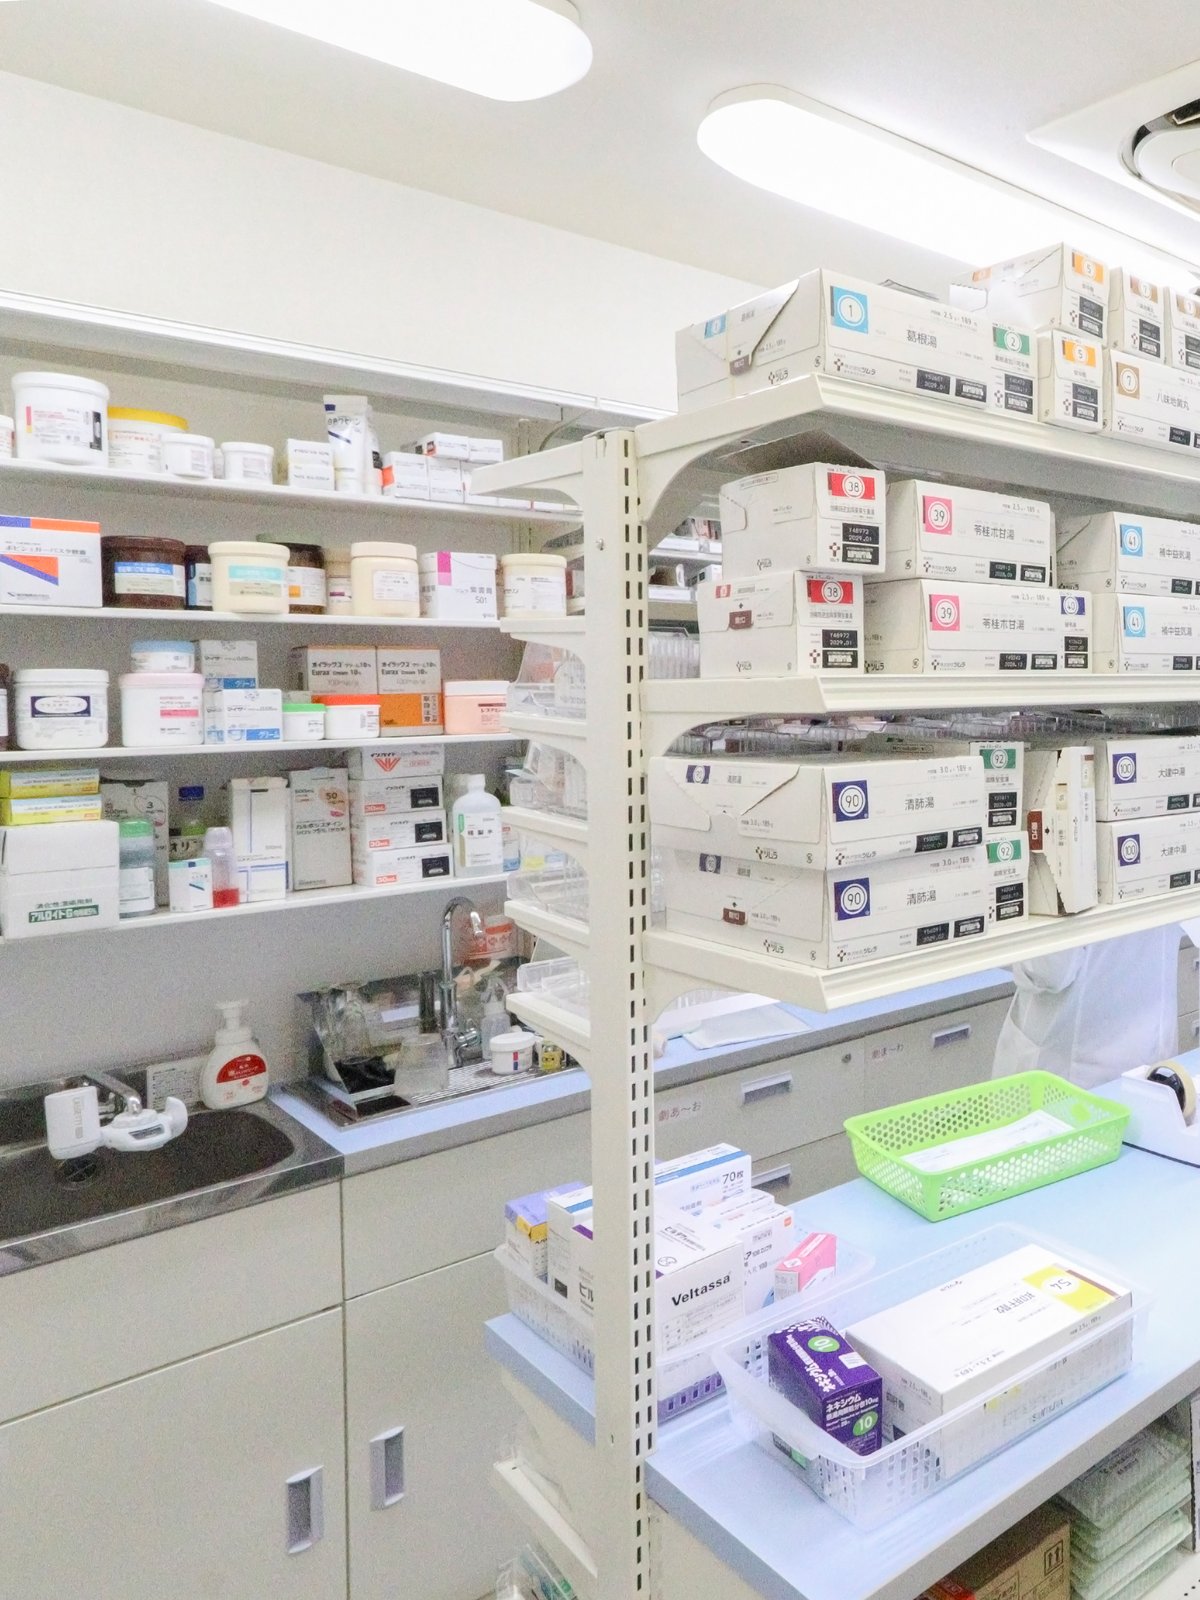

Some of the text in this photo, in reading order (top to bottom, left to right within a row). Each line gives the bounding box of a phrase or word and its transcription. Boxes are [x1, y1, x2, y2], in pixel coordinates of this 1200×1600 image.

[906, 329, 938, 348] 葛根湯
[847, 481, 860, 493] 38
[933, 508, 946, 522] 39
[827, 586, 839, 598] 38
[940, 606, 953, 619] 39
[1120, 762, 1133, 775] 100
[1158, 766, 1186, 778] 大建中湯
[844, 793, 859, 806] 90
[905, 796, 935, 811] 清肺湯
[1123, 844, 1136, 857] 100
[1160, 845, 1187, 857] 大建中湯
[847, 892, 862, 905] 90
[906, 890, 937, 906] 清肺湯
[671, 1274, 731, 1307] Veltassa
[1050, 1278, 1072, 1291] 54
[826, 1393, 862, 1413] ネキシウム
[858, 1415, 873, 1431] 10
